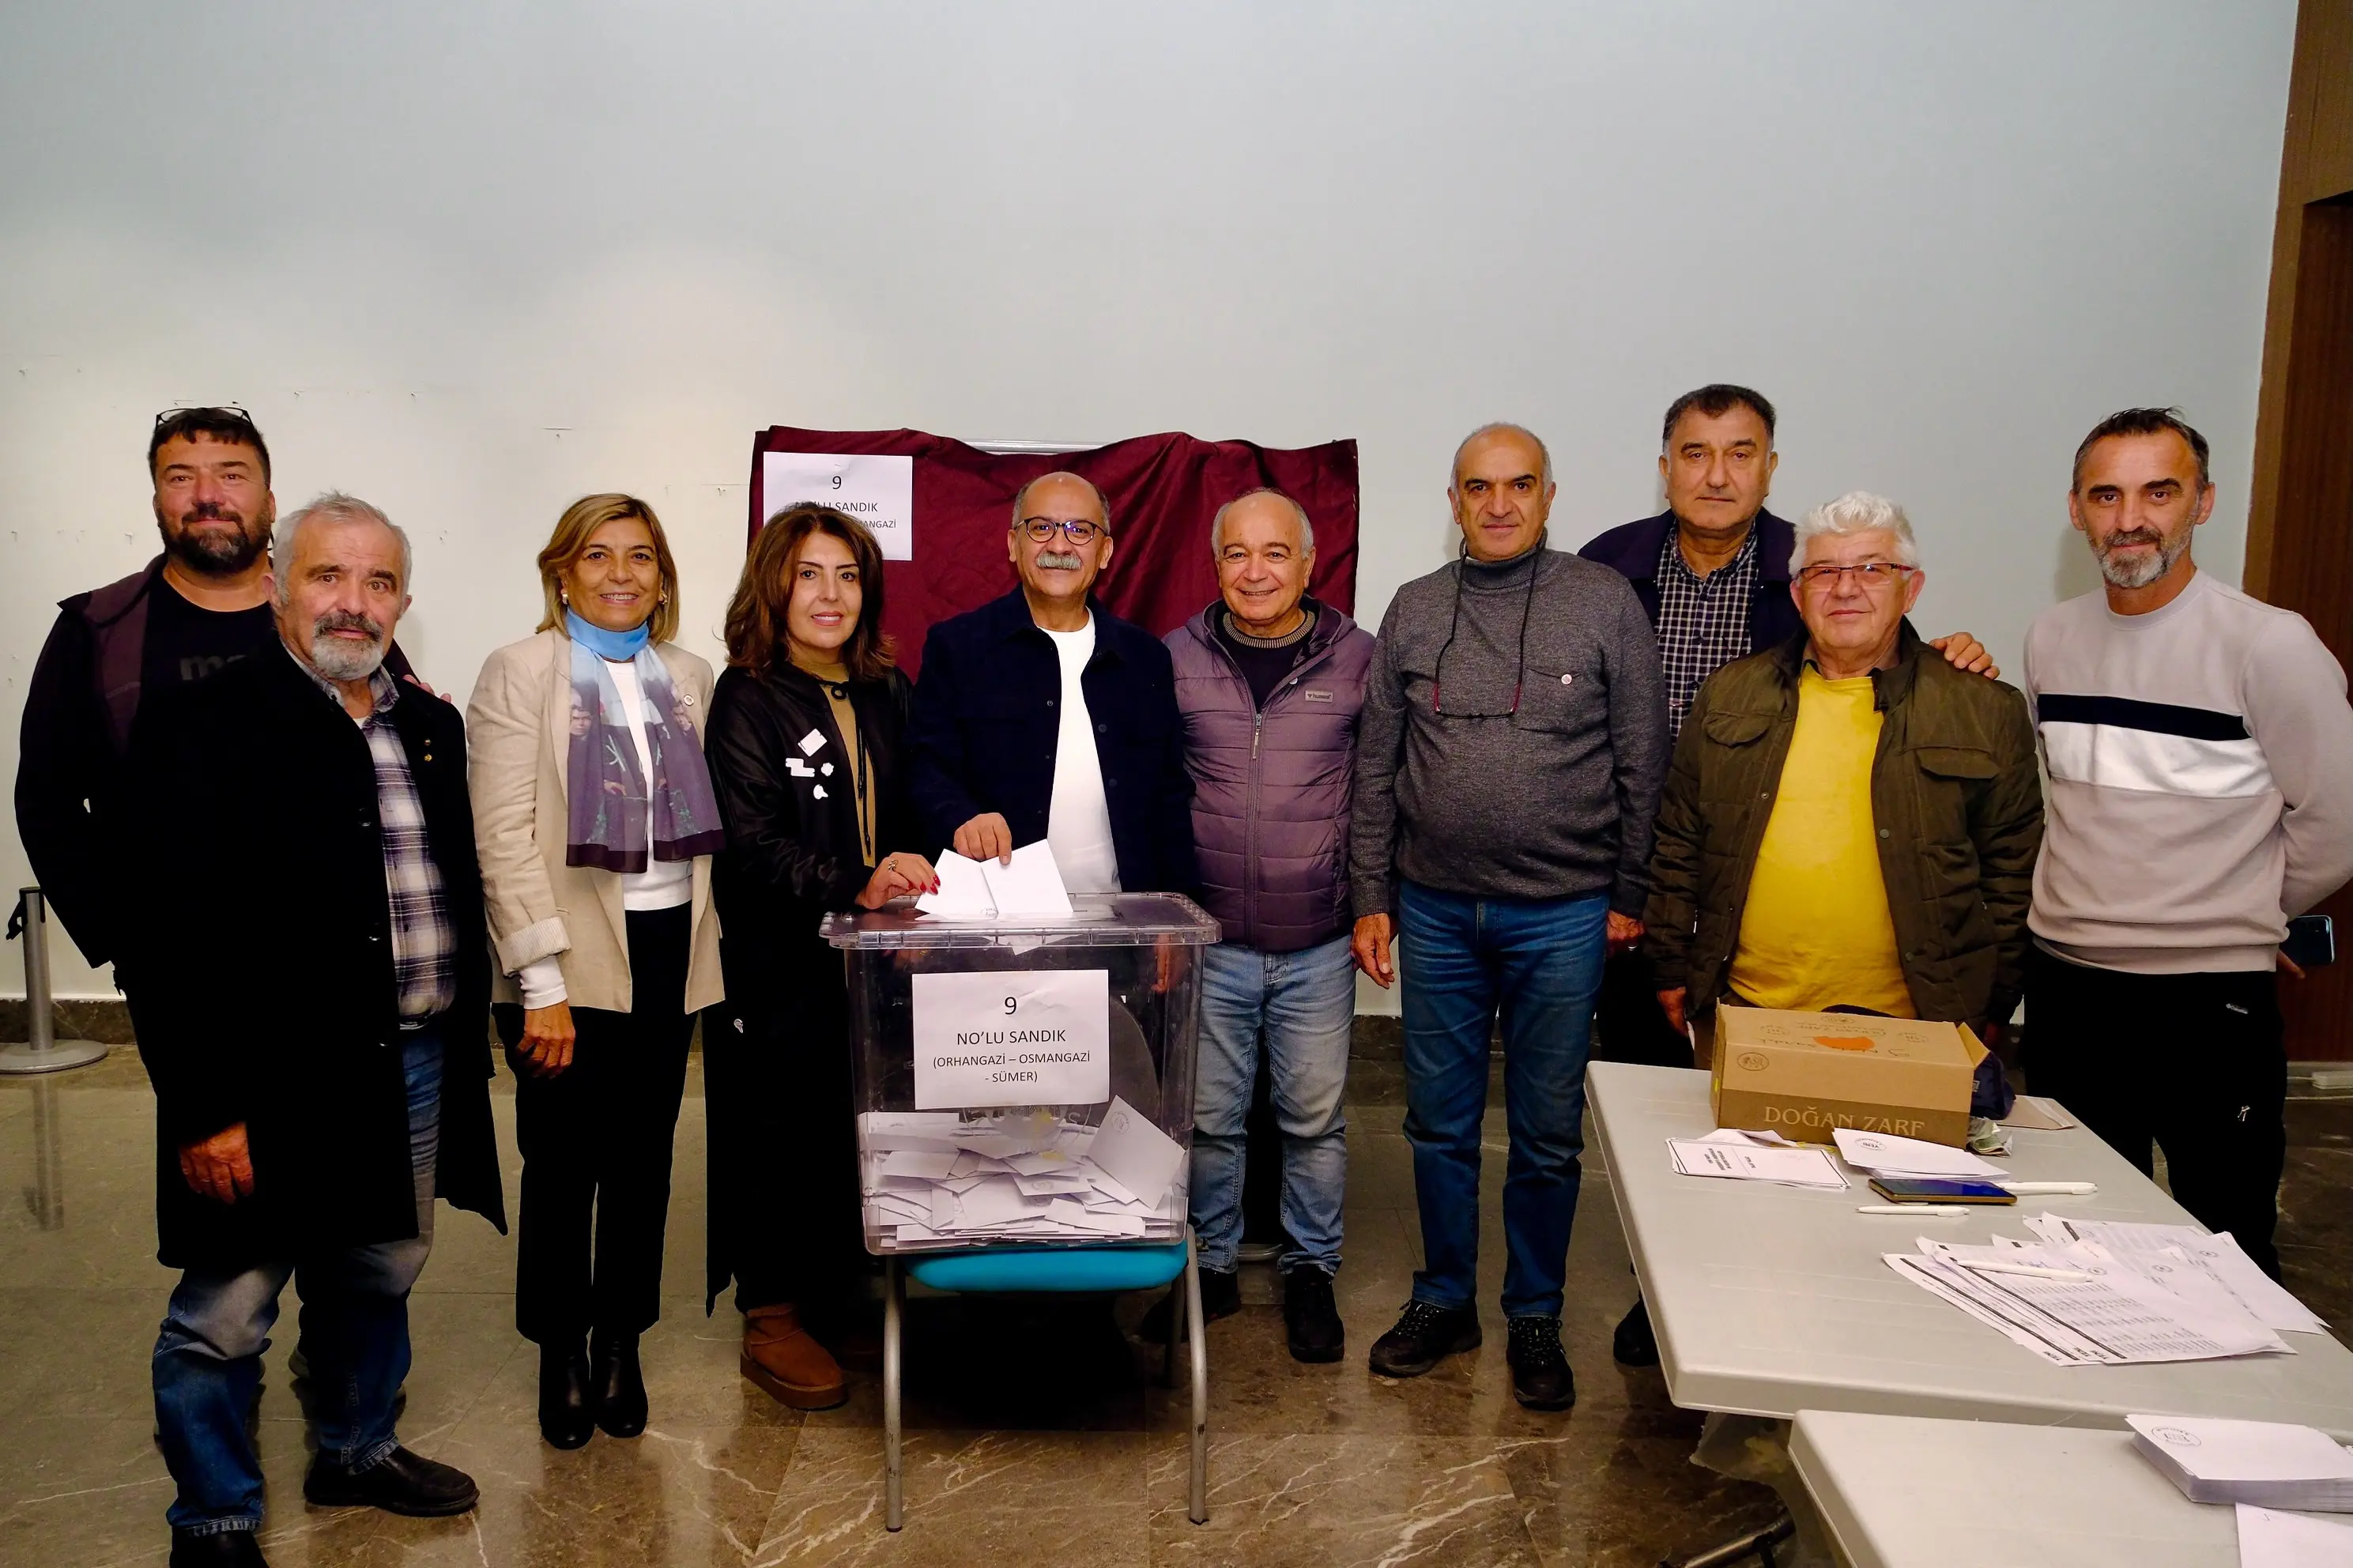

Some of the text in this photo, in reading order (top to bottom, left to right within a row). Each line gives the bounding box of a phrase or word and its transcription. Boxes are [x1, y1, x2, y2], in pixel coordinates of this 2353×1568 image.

[832, 476, 842, 490] 9
[835, 502, 878, 512] SANDIK
[1004, 996, 1017, 1016] 9
[1009, 1029, 1066, 1044] SANDIK
[933, 1053, 1006, 1069] (ORHANGAZİ
[1018, 1050, 1090, 1065] OSMANGAZİ
[992, 1070, 1038, 1084] SÜMER)
[1764, 1106, 1925, 1136] DOĞAN ZARF
